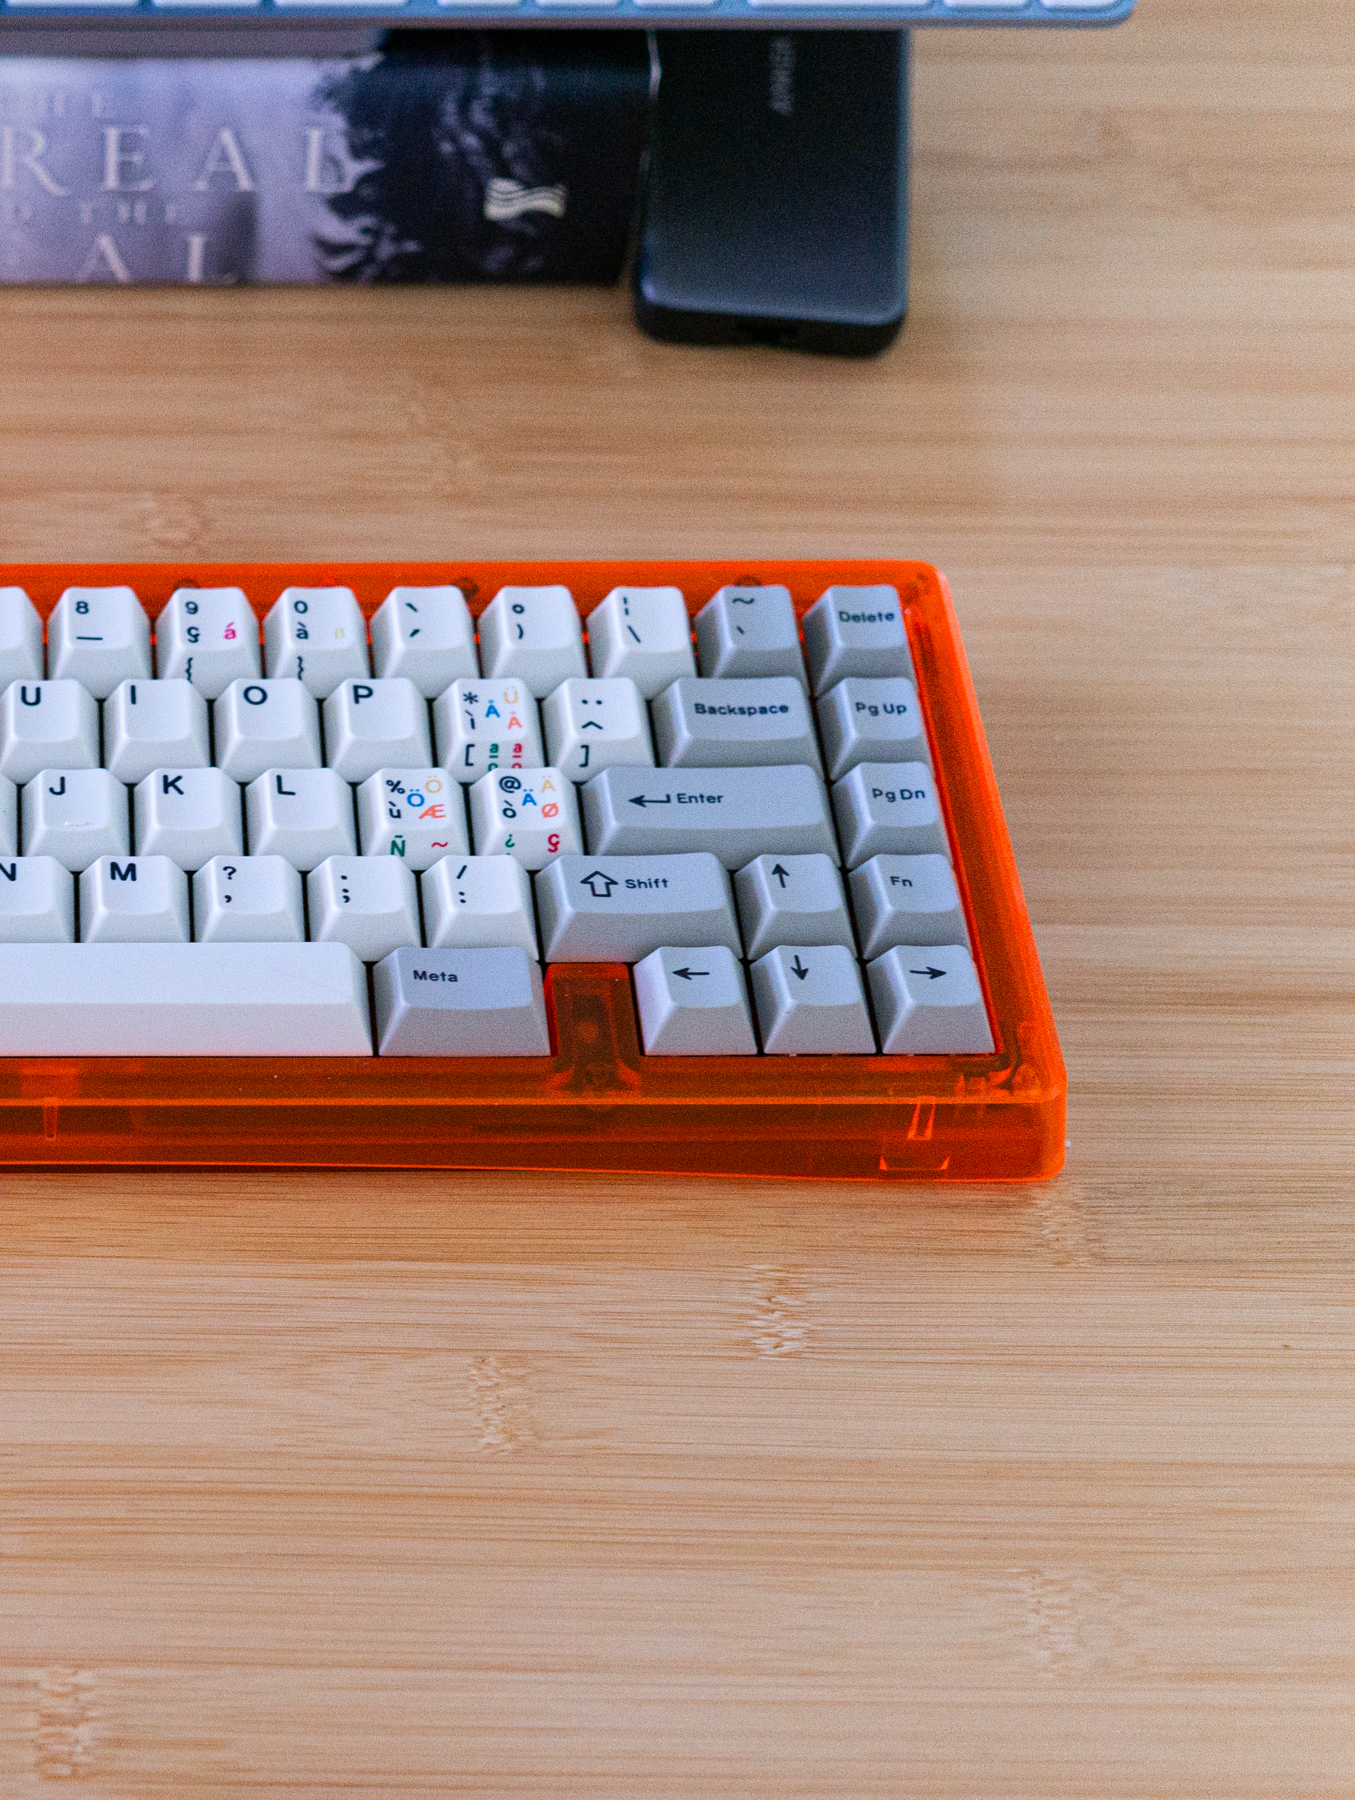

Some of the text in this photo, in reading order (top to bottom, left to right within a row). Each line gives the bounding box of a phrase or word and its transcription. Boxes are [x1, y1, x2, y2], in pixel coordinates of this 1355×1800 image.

[75, 601, 89, 614] 8
[185, 601, 198, 615] 9
[838, 610, 894, 623] Delete
[187, 626, 200, 643] ç
[296, 622, 309, 639] à
[21, 686, 41, 706] U
[243, 686, 267, 705] O
[353, 685, 373, 704] P
[694, 703, 789, 716] Backspace
[855, 702, 907, 716] Pg Up
[465, 744, 475, 767] [
[579, 745, 589, 768] ]
[49, 776, 65, 795] J
[163, 775, 183, 795] K
[276, 775, 295, 795] L
[386, 780, 405, 794] %
[499, 776, 522, 793] @
[407, 789, 425, 807] Ö
[677, 793, 723, 804] Enter
[872, 788, 925, 803] Pg Dn
[502, 800, 516, 818] ò
[110, 862, 136, 881] M
[223, 866, 236, 880] ?
[457, 865, 467, 879] /
[625, 878, 668, 889] Shift
[890, 876, 913, 887] Fn
[413, 970, 458, 982] Meta
